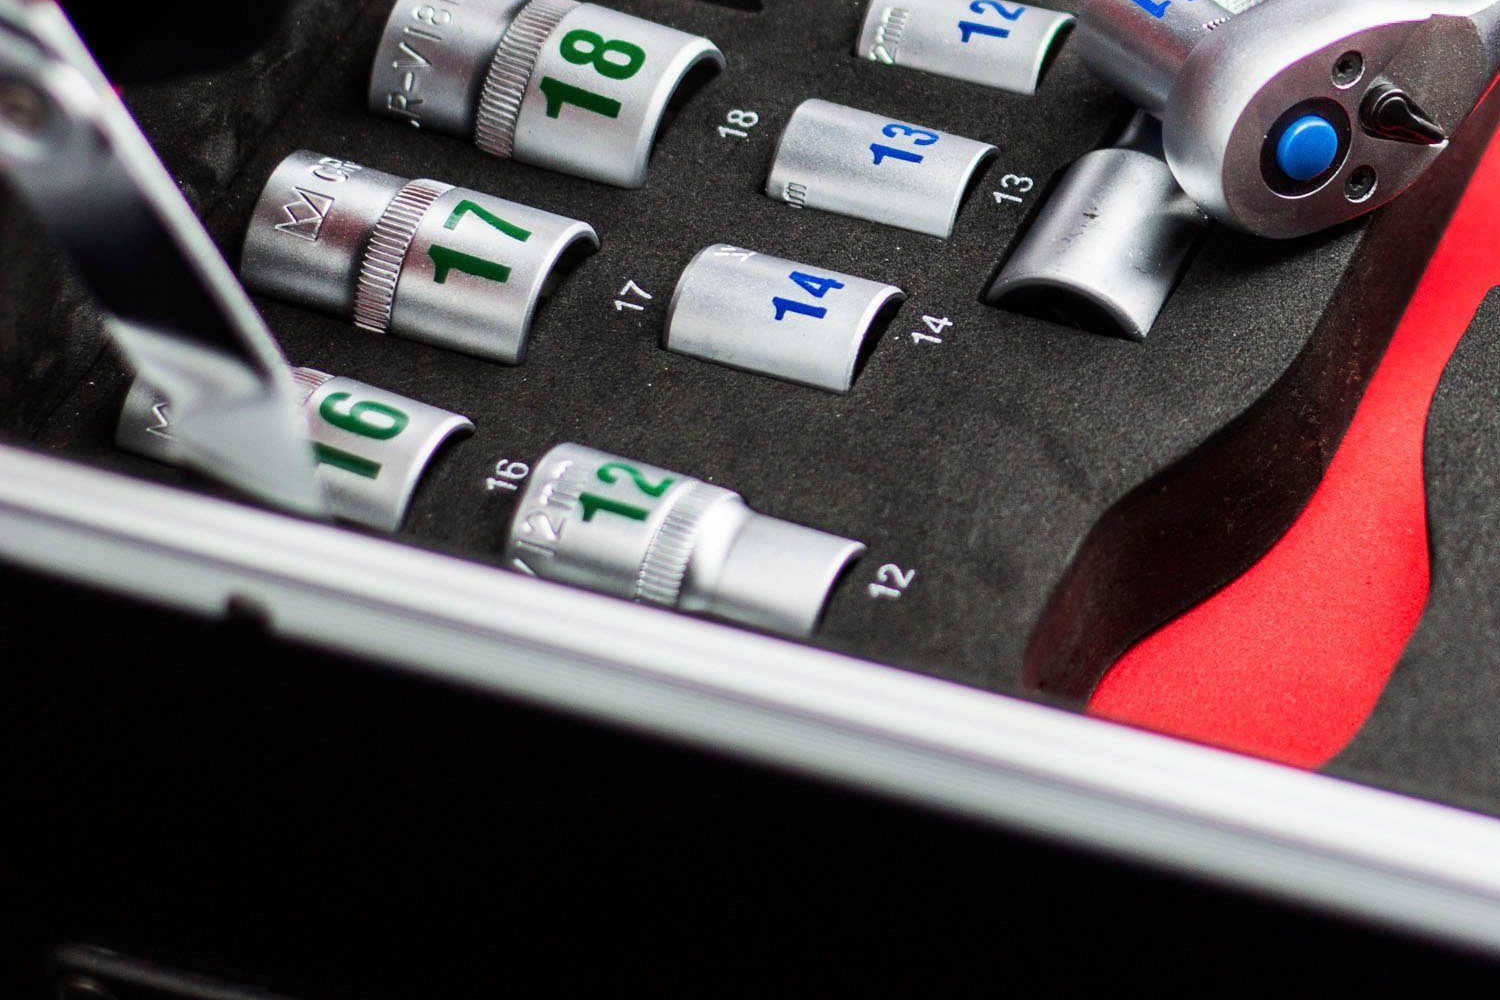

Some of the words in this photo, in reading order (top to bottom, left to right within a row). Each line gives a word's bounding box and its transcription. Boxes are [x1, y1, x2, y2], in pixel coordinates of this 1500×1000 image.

[538, 28, 648, 120] 18
[718, 109, 759, 138] 18
[868, 122, 942, 167] 13
[992, 173, 1034, 204] 13
[428, 199, 533, 285] 17
[614, 279, 653, 312] 17
[771, 270, 847, 322] 14
[911, 314, 955, 345] 14
[313, 391, 411, 480] 16
[486, 458, 530, 491] 16
[578, 461, 676, 523] 12
[868, 563, 916, 599] 12
